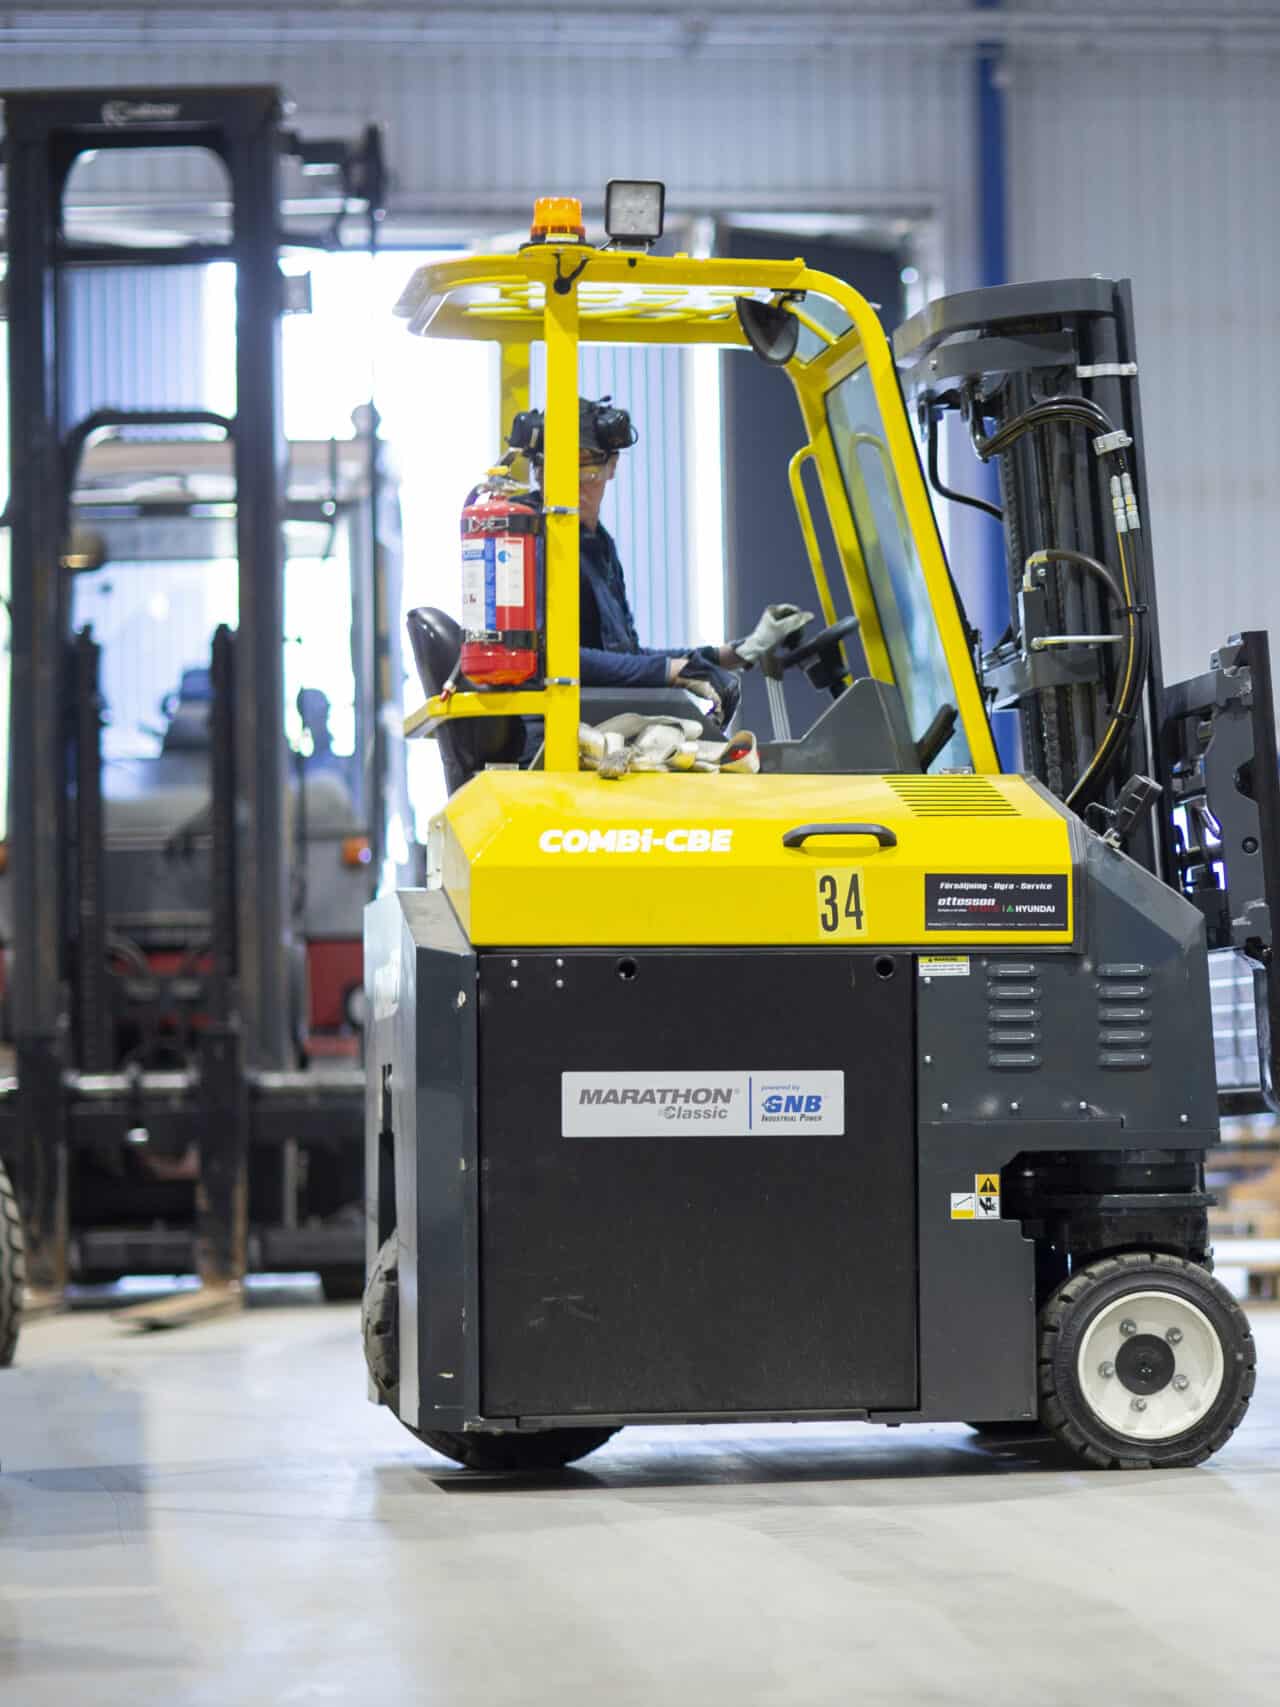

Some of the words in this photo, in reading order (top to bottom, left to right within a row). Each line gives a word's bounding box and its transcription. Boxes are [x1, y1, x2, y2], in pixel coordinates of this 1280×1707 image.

[1020, 882, 1052, 890] Service
[819, 873, 864, 932] 34
[1015, 904, 1055, 913] HYUNDAI
[578, 1088, 733, 1105] MARATHON
[761, 1095, 822, 1113] GNB
[663, 1105, 729, 1120] Classic
